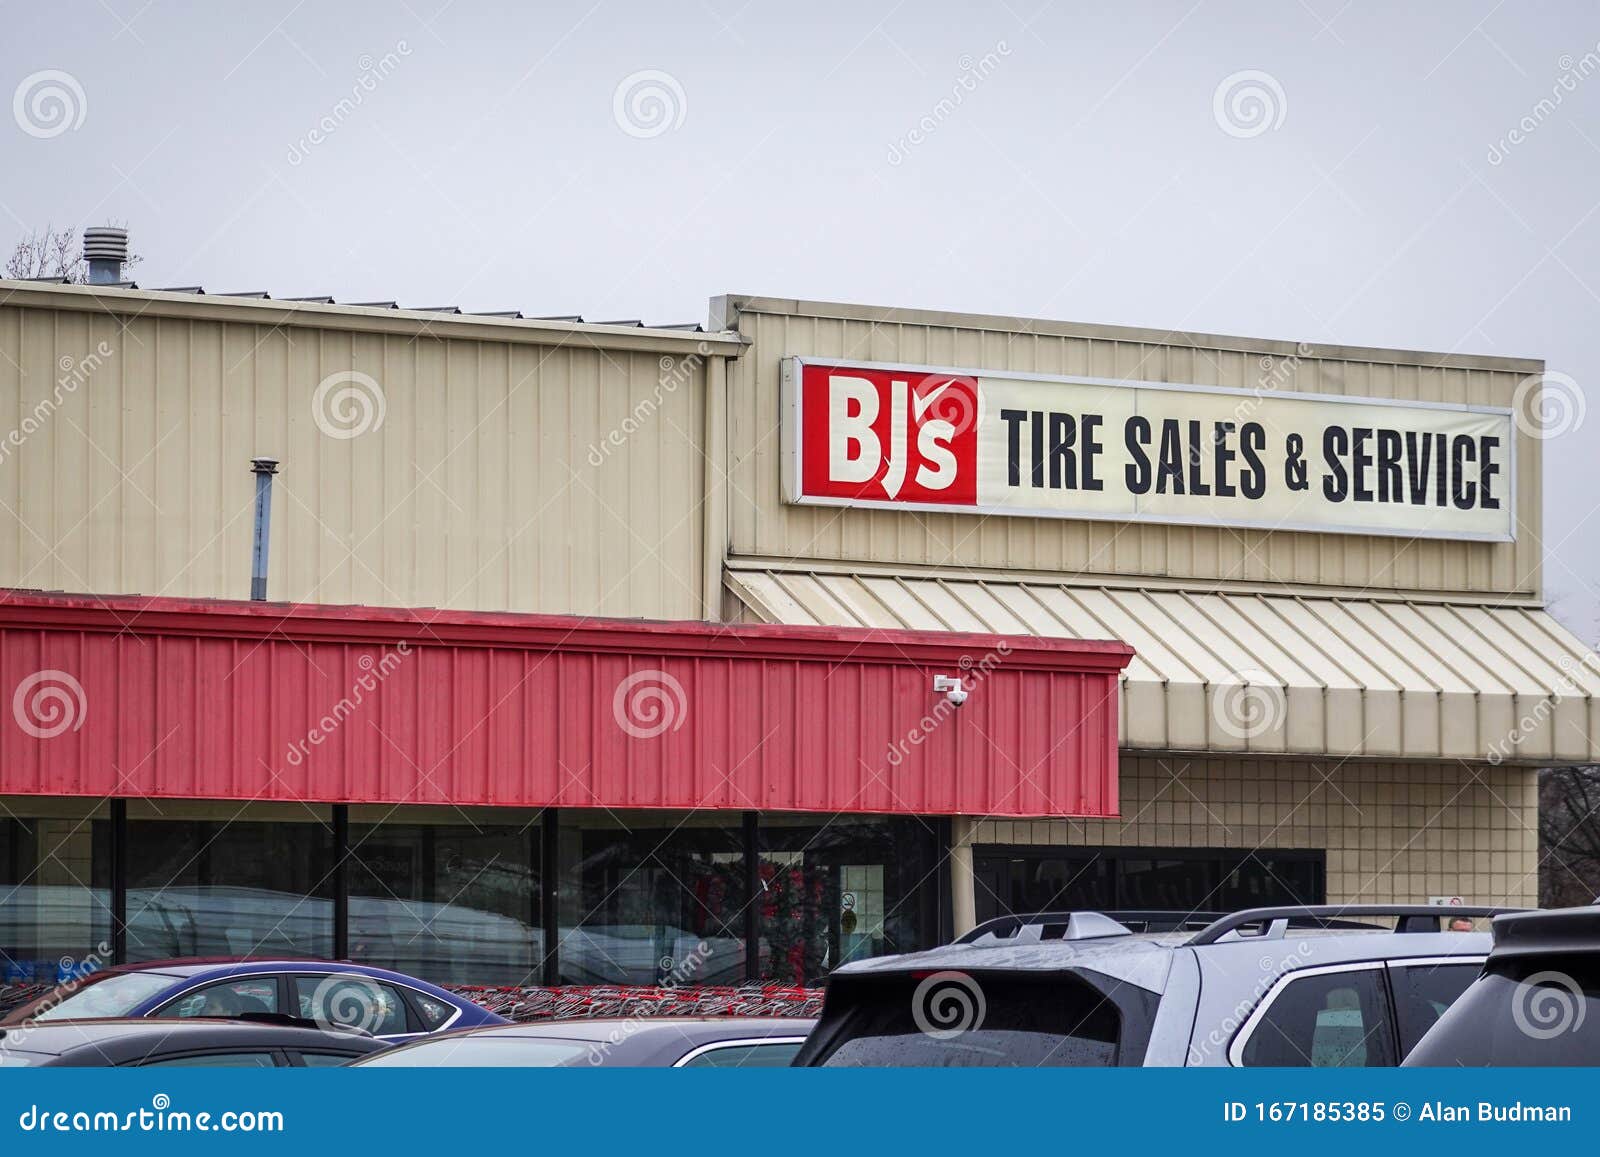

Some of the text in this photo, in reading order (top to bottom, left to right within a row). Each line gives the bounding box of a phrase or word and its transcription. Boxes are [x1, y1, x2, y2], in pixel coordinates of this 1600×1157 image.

[1001, 408, 1103, 491] TIRE
[1124, 416, 1266, 500] SALES
[1285, 432, 1308, 492] &
[1322, 426, 1500, 510] SERVICE
